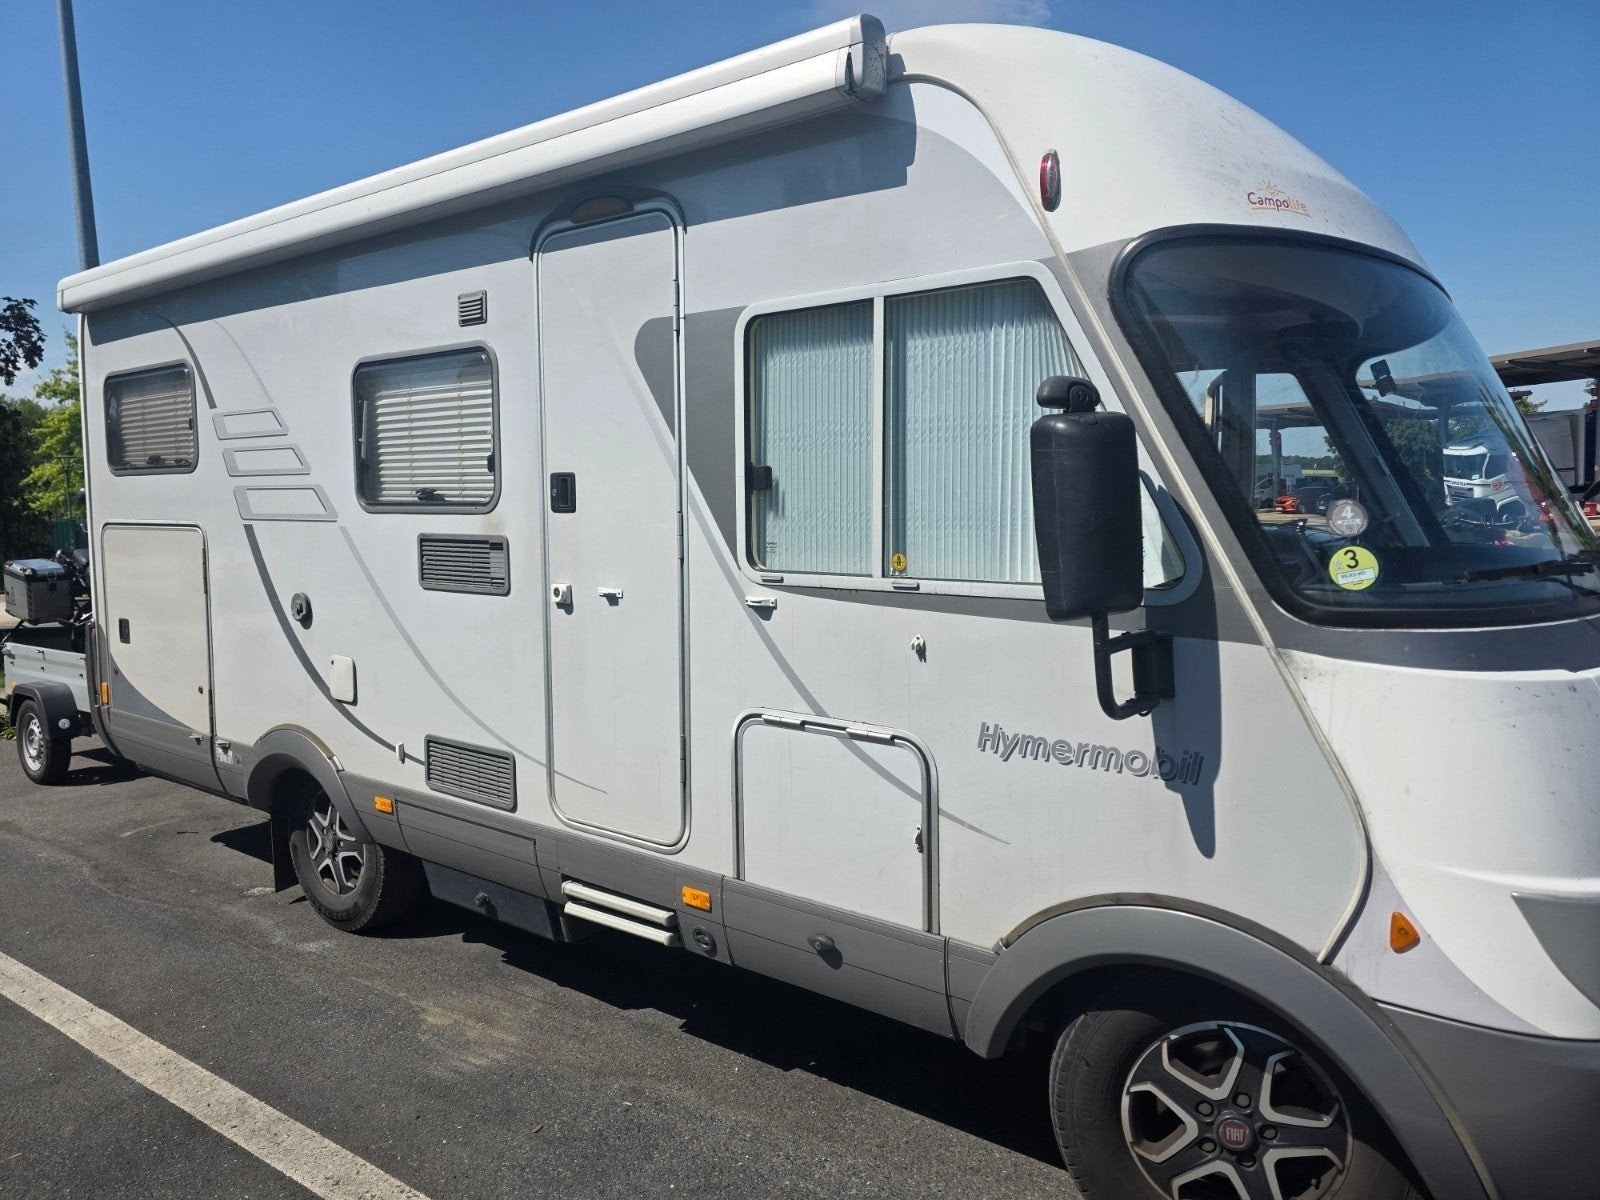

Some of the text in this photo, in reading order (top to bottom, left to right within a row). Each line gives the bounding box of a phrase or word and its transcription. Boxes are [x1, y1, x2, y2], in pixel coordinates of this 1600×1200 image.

[1247, 192, 1307, 212] Campolife
[1341, 505, 1354, 519] 4
[1343, 549, 1359, 569] 3
[977, 721, 1205, 785] Hymermobil
[1225, 1127, 1245, 1142] FIAT
